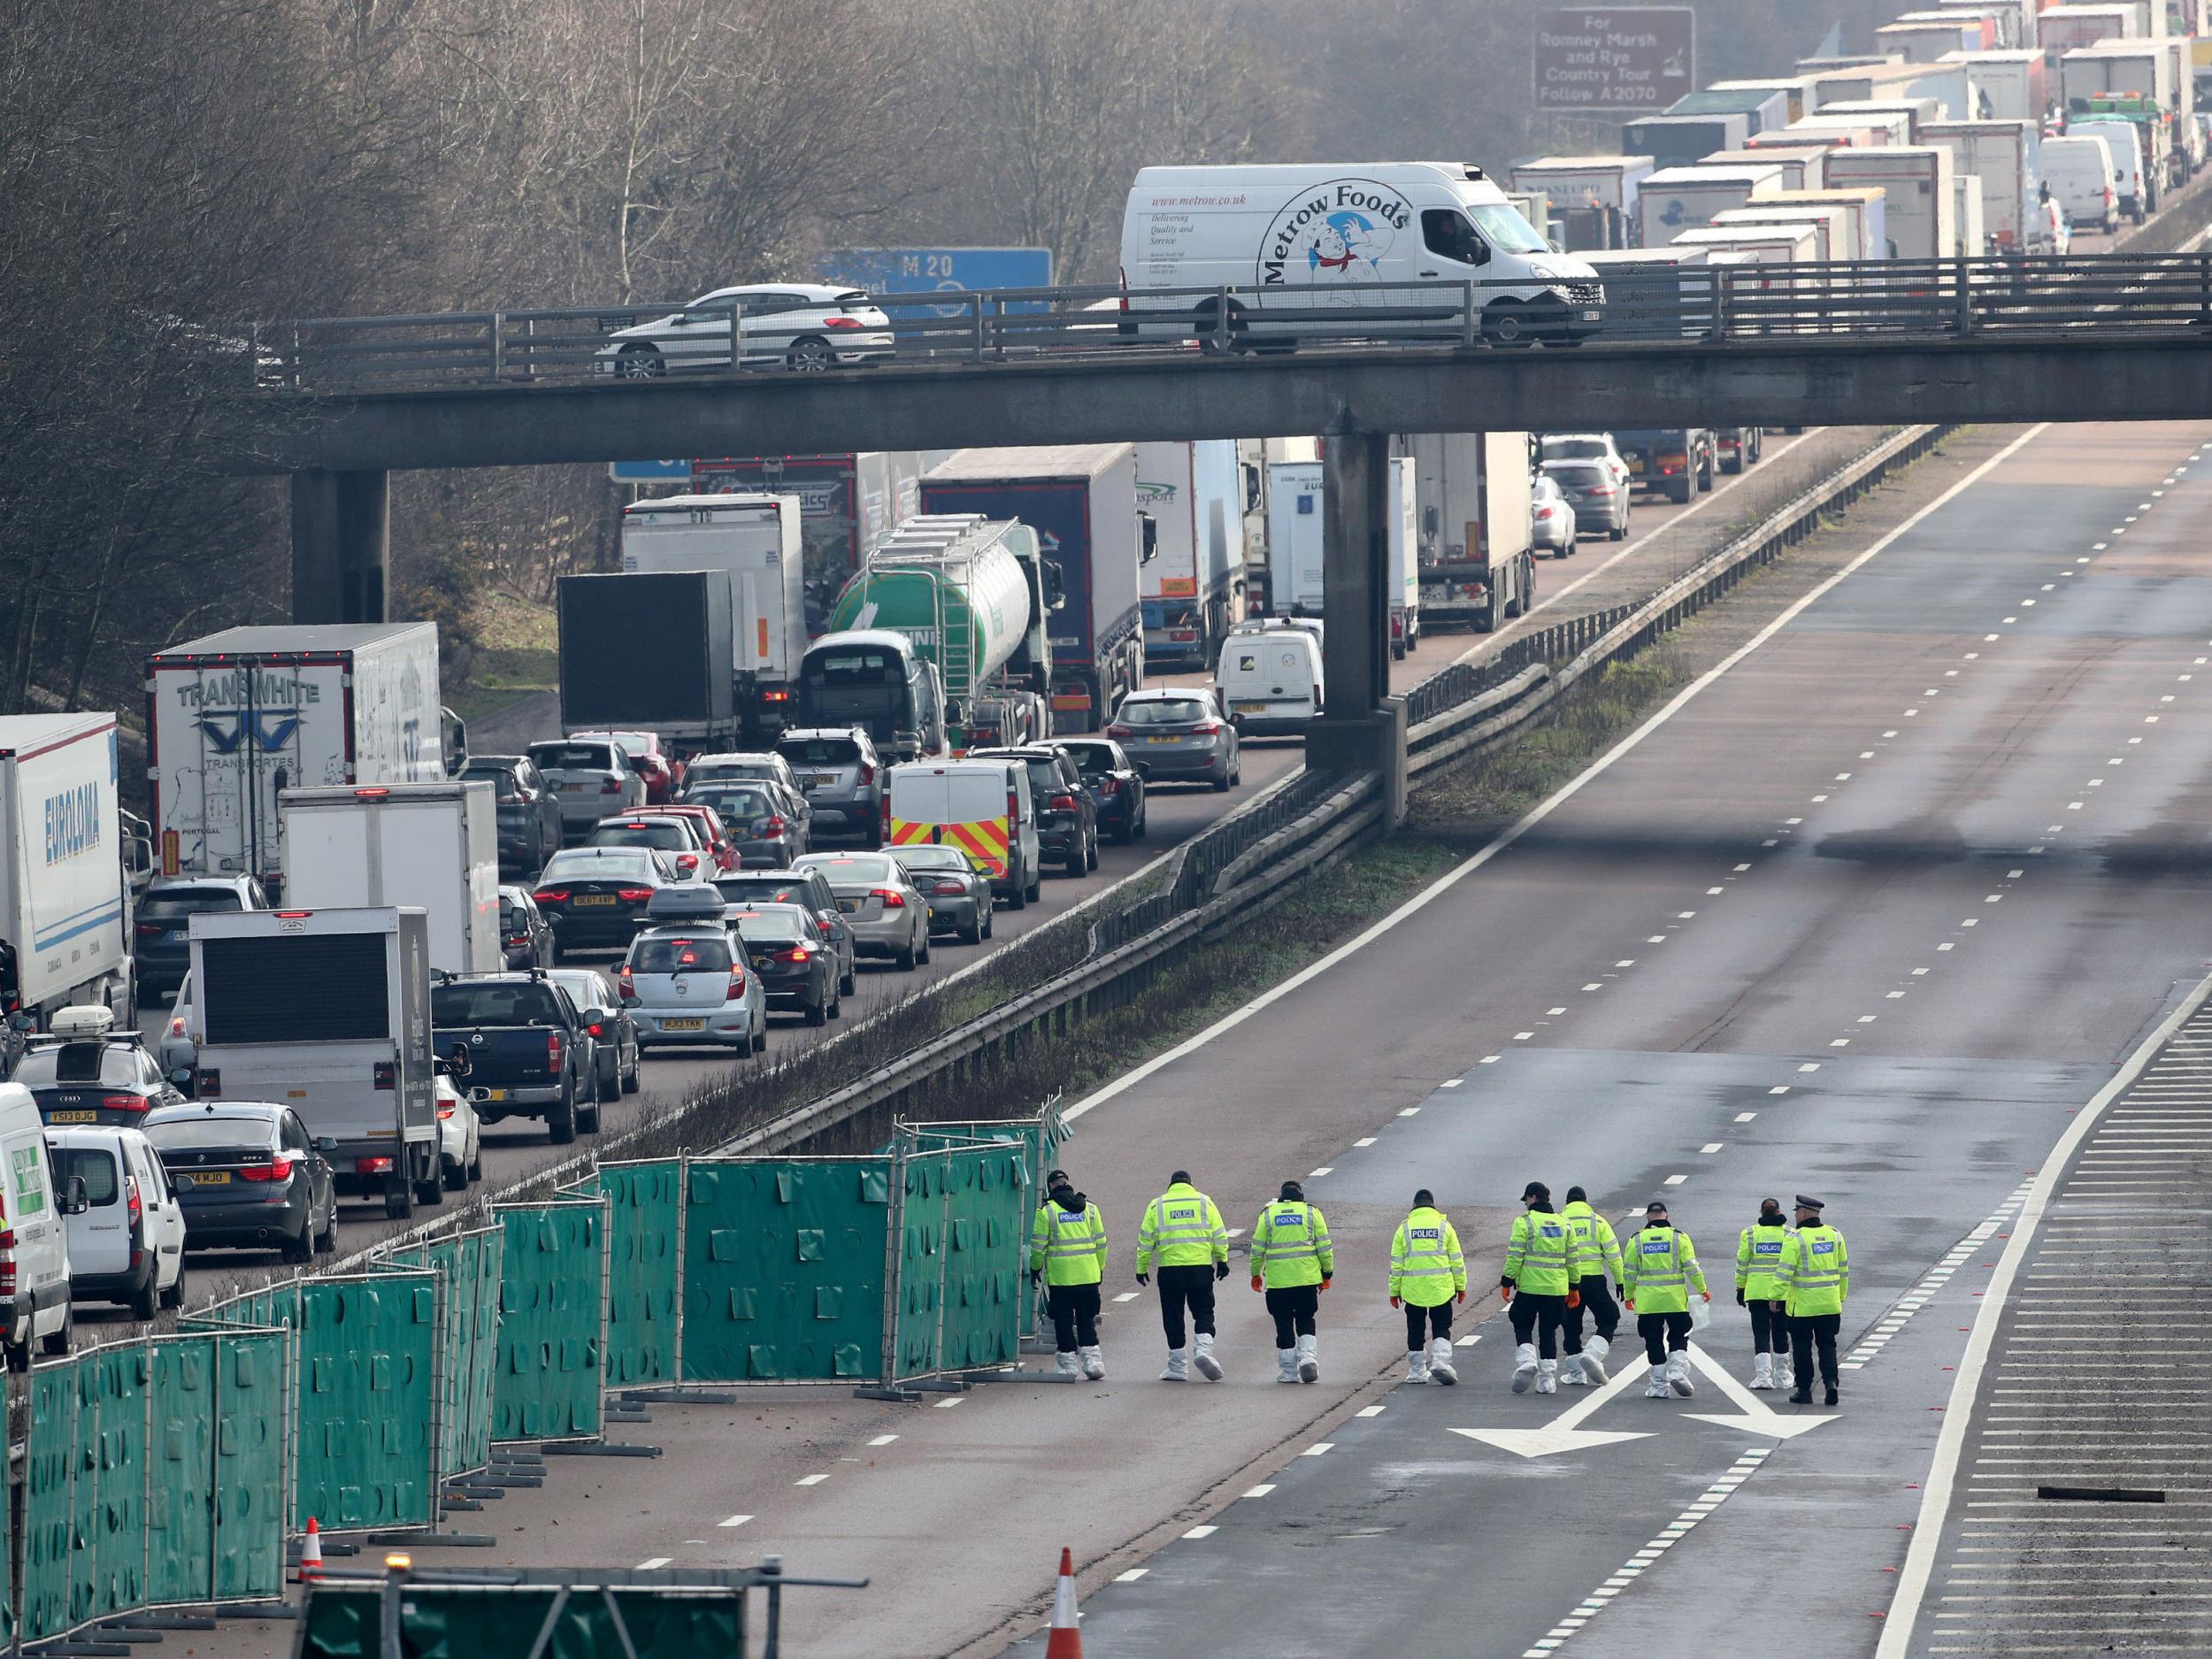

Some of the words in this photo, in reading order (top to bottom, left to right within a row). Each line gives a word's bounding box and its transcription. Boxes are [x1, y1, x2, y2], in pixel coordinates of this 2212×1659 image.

[1585, 15, 1611, 29] For
[1540, 32, 1600, 49] Romney
[1608, 33, 1656, 46] Marsh
[1566, 48, 1594, 64] and
[1600, 50, 1630, 66] Rye
[1546, 67, 1610, 82] Country
[1618, 68, 1650, 81] Tour
[1540, 87, 1593, 101] Follow
[1152, 194, 1246, 206] www.metrow.co.uk
[1151, 213, 1189, 223] Delivering
[1150, 226, 1177, 235] Quality
[1264, 196, 1328, 285] Metrow
[1336, 185, 1409, 230] Foods
[177, 672, 320, 707] TRANSWHITE
[205, 757, 294, 770] TRANSORTES
[44, 780, 100, 866] EUROLOMA
[665, 1018, 684, 1027] HJ13
[685, 1018, 701, 1027] TKK
[53, 1112, 73, 1121] YS13
[74, 1111, 93, 1120] OJG
